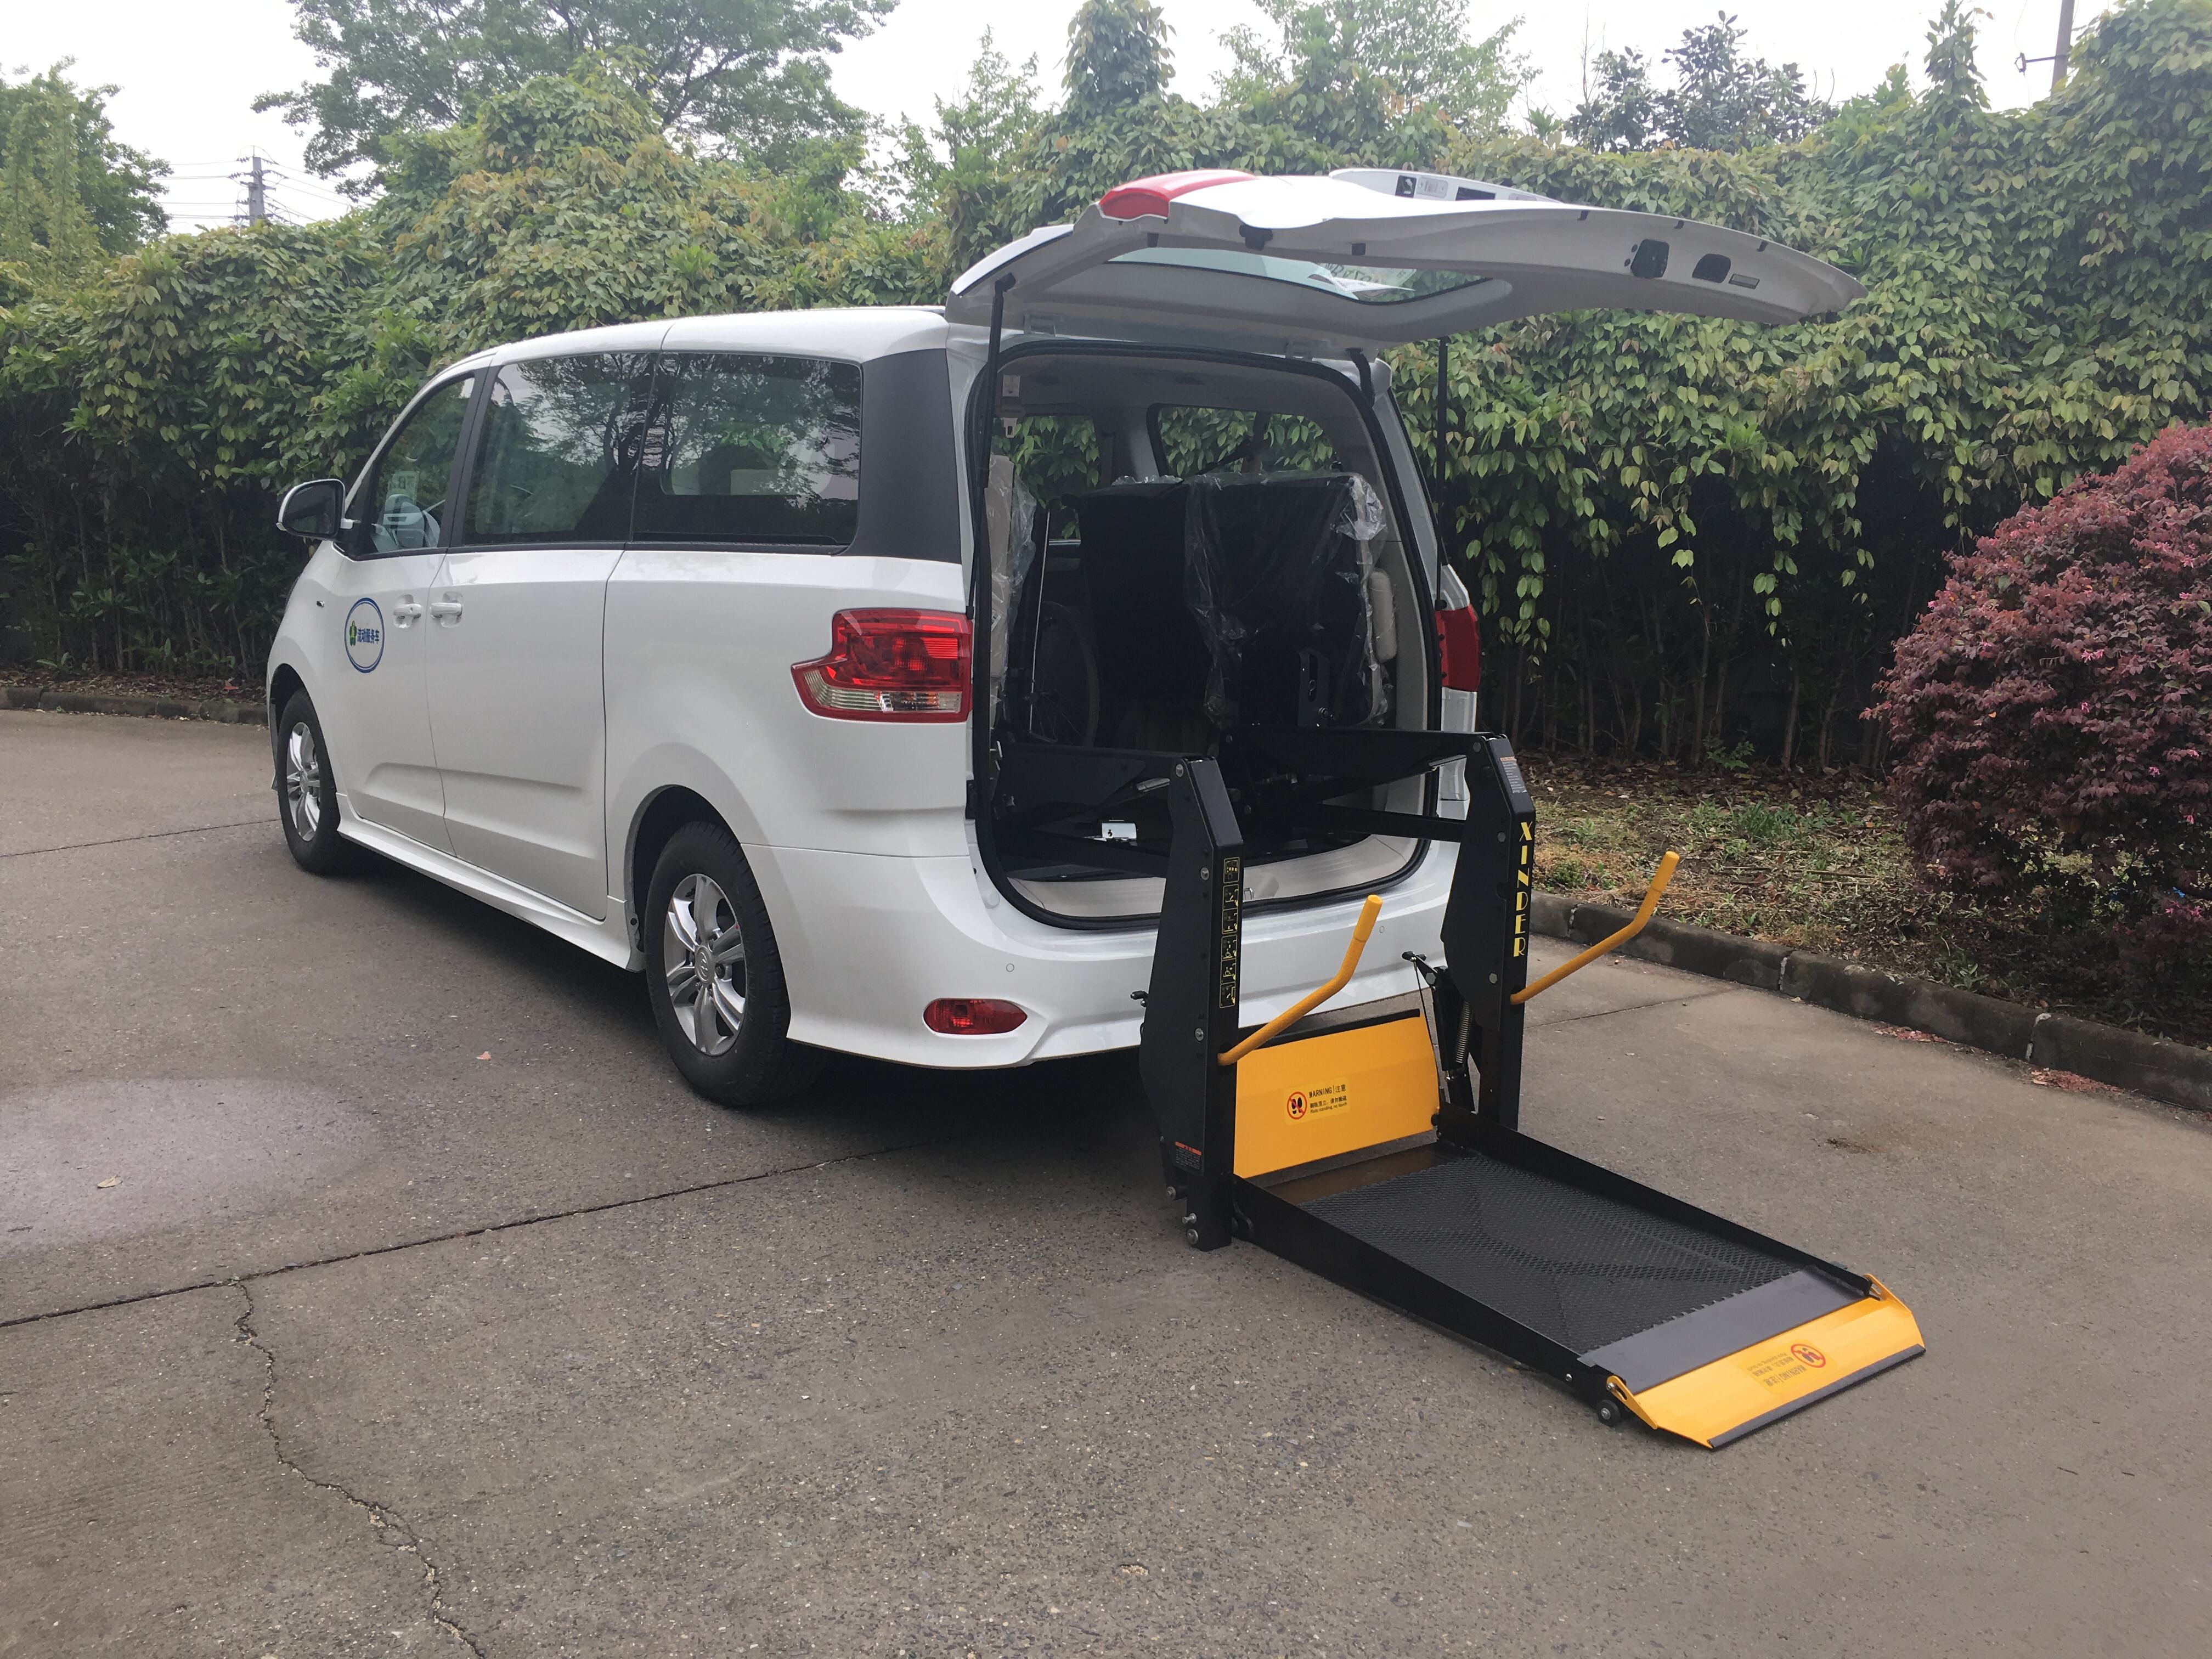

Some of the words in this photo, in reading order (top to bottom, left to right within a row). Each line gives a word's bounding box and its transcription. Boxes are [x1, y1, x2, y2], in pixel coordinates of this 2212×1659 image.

[1514, 821, 1533, 957] XINDER
[1309, 1087, 1332, 1098] WARNING
[1335, 1085, 1346, 1093] 注意
[1779, 1364, 1807, 1380] WARNING
